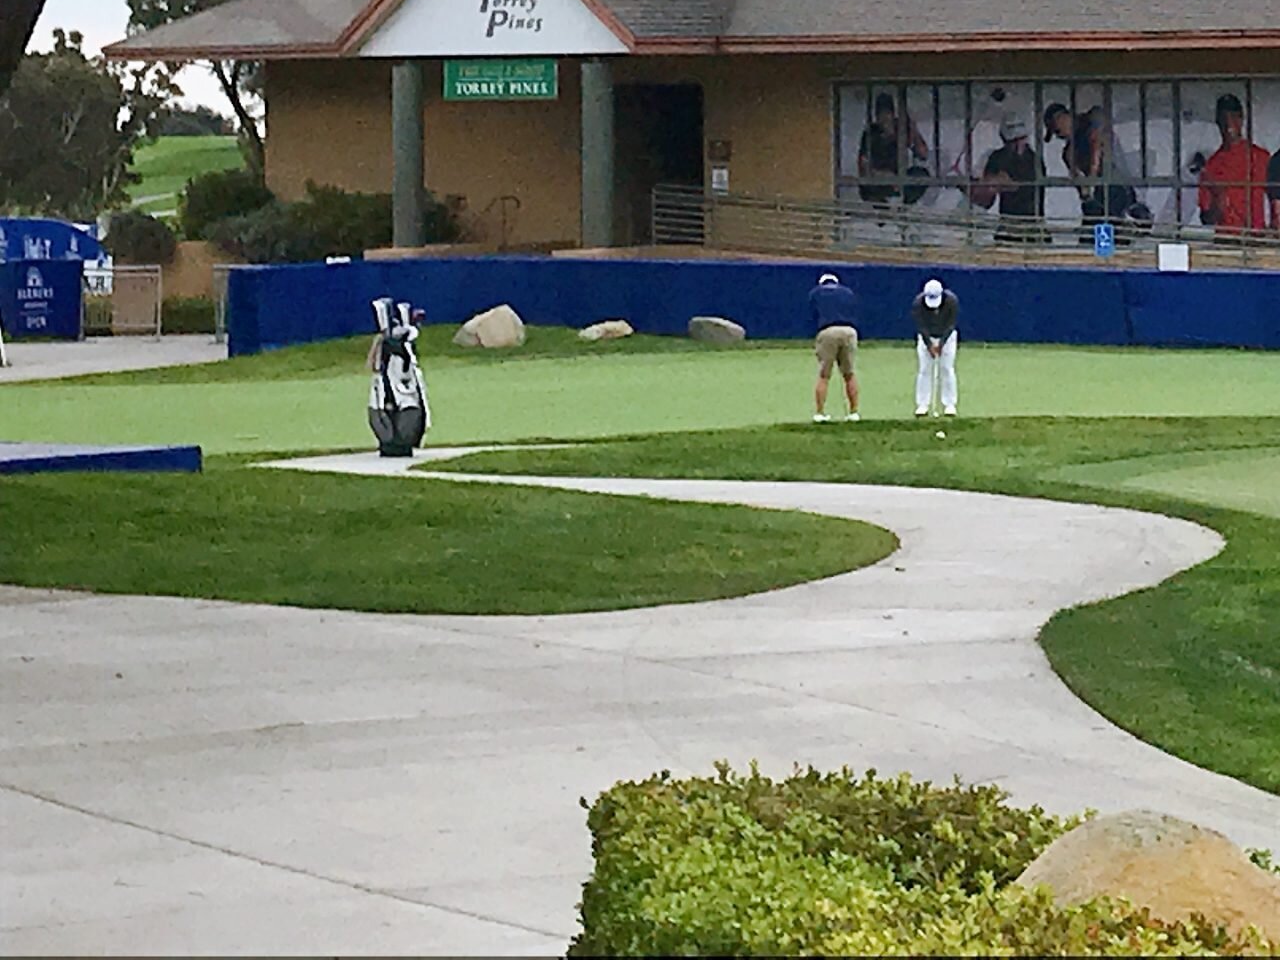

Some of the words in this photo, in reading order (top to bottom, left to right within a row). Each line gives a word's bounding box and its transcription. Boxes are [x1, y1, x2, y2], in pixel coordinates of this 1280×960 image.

[486, 10, 543, 37] Pines
[455, 81, 504, 96] TORREY
[509, 81, 549, 96] PINES
